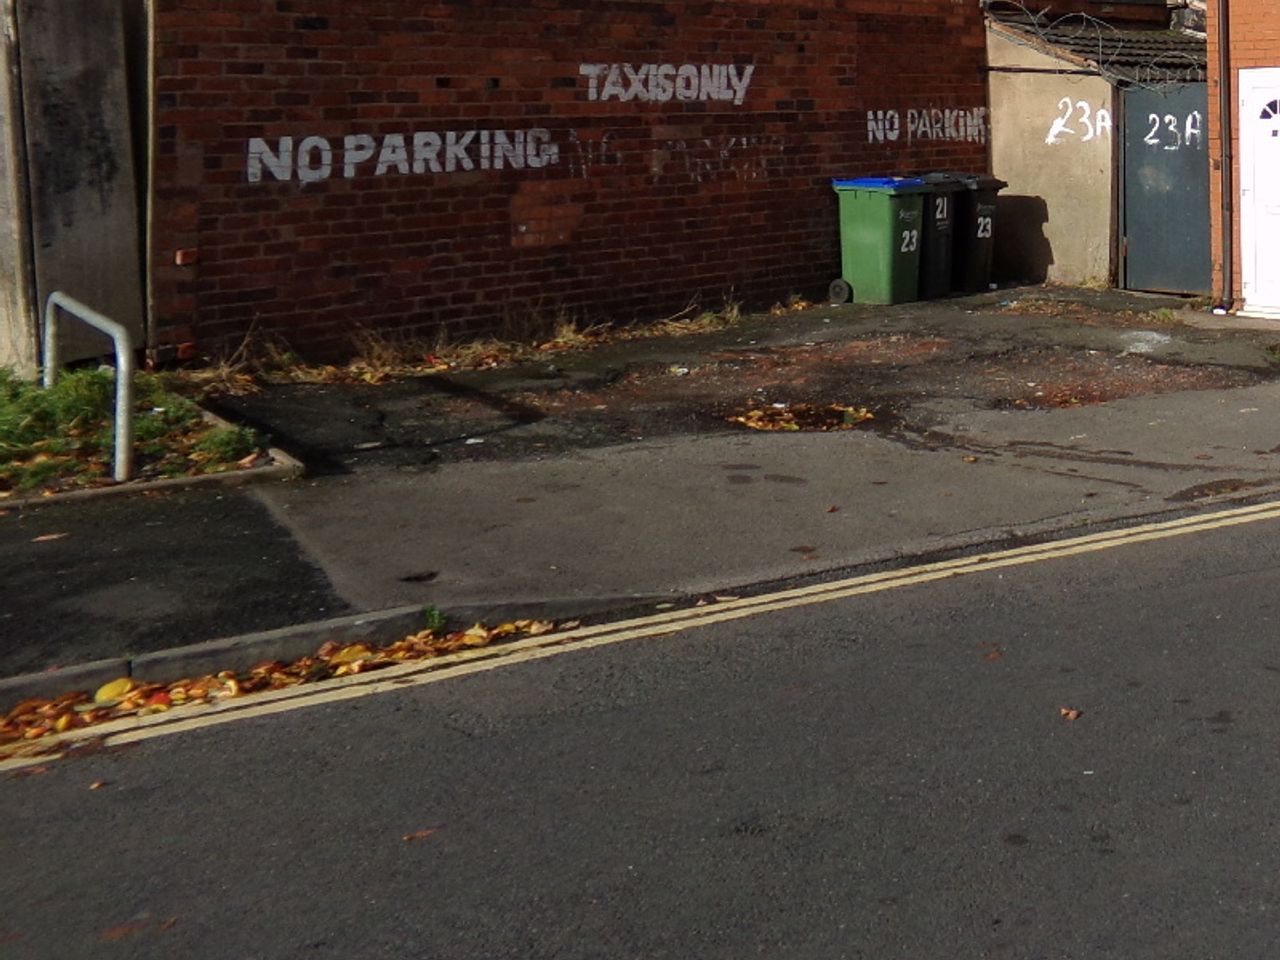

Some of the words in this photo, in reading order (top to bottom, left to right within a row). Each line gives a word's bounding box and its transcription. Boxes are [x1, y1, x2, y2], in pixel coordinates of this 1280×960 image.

[866, 109, 899, 145] NO
[1045, 96, 1113, 145] 23A
[1143, 110, 1203, 151] 23A
[247, 135, 332, 185] NO
[343, 128, 560, 178] PARKING
[935, 196, 948, 219] 21
[901, 229, 919, 253] 23
[977, 216, 993, 239] 23
